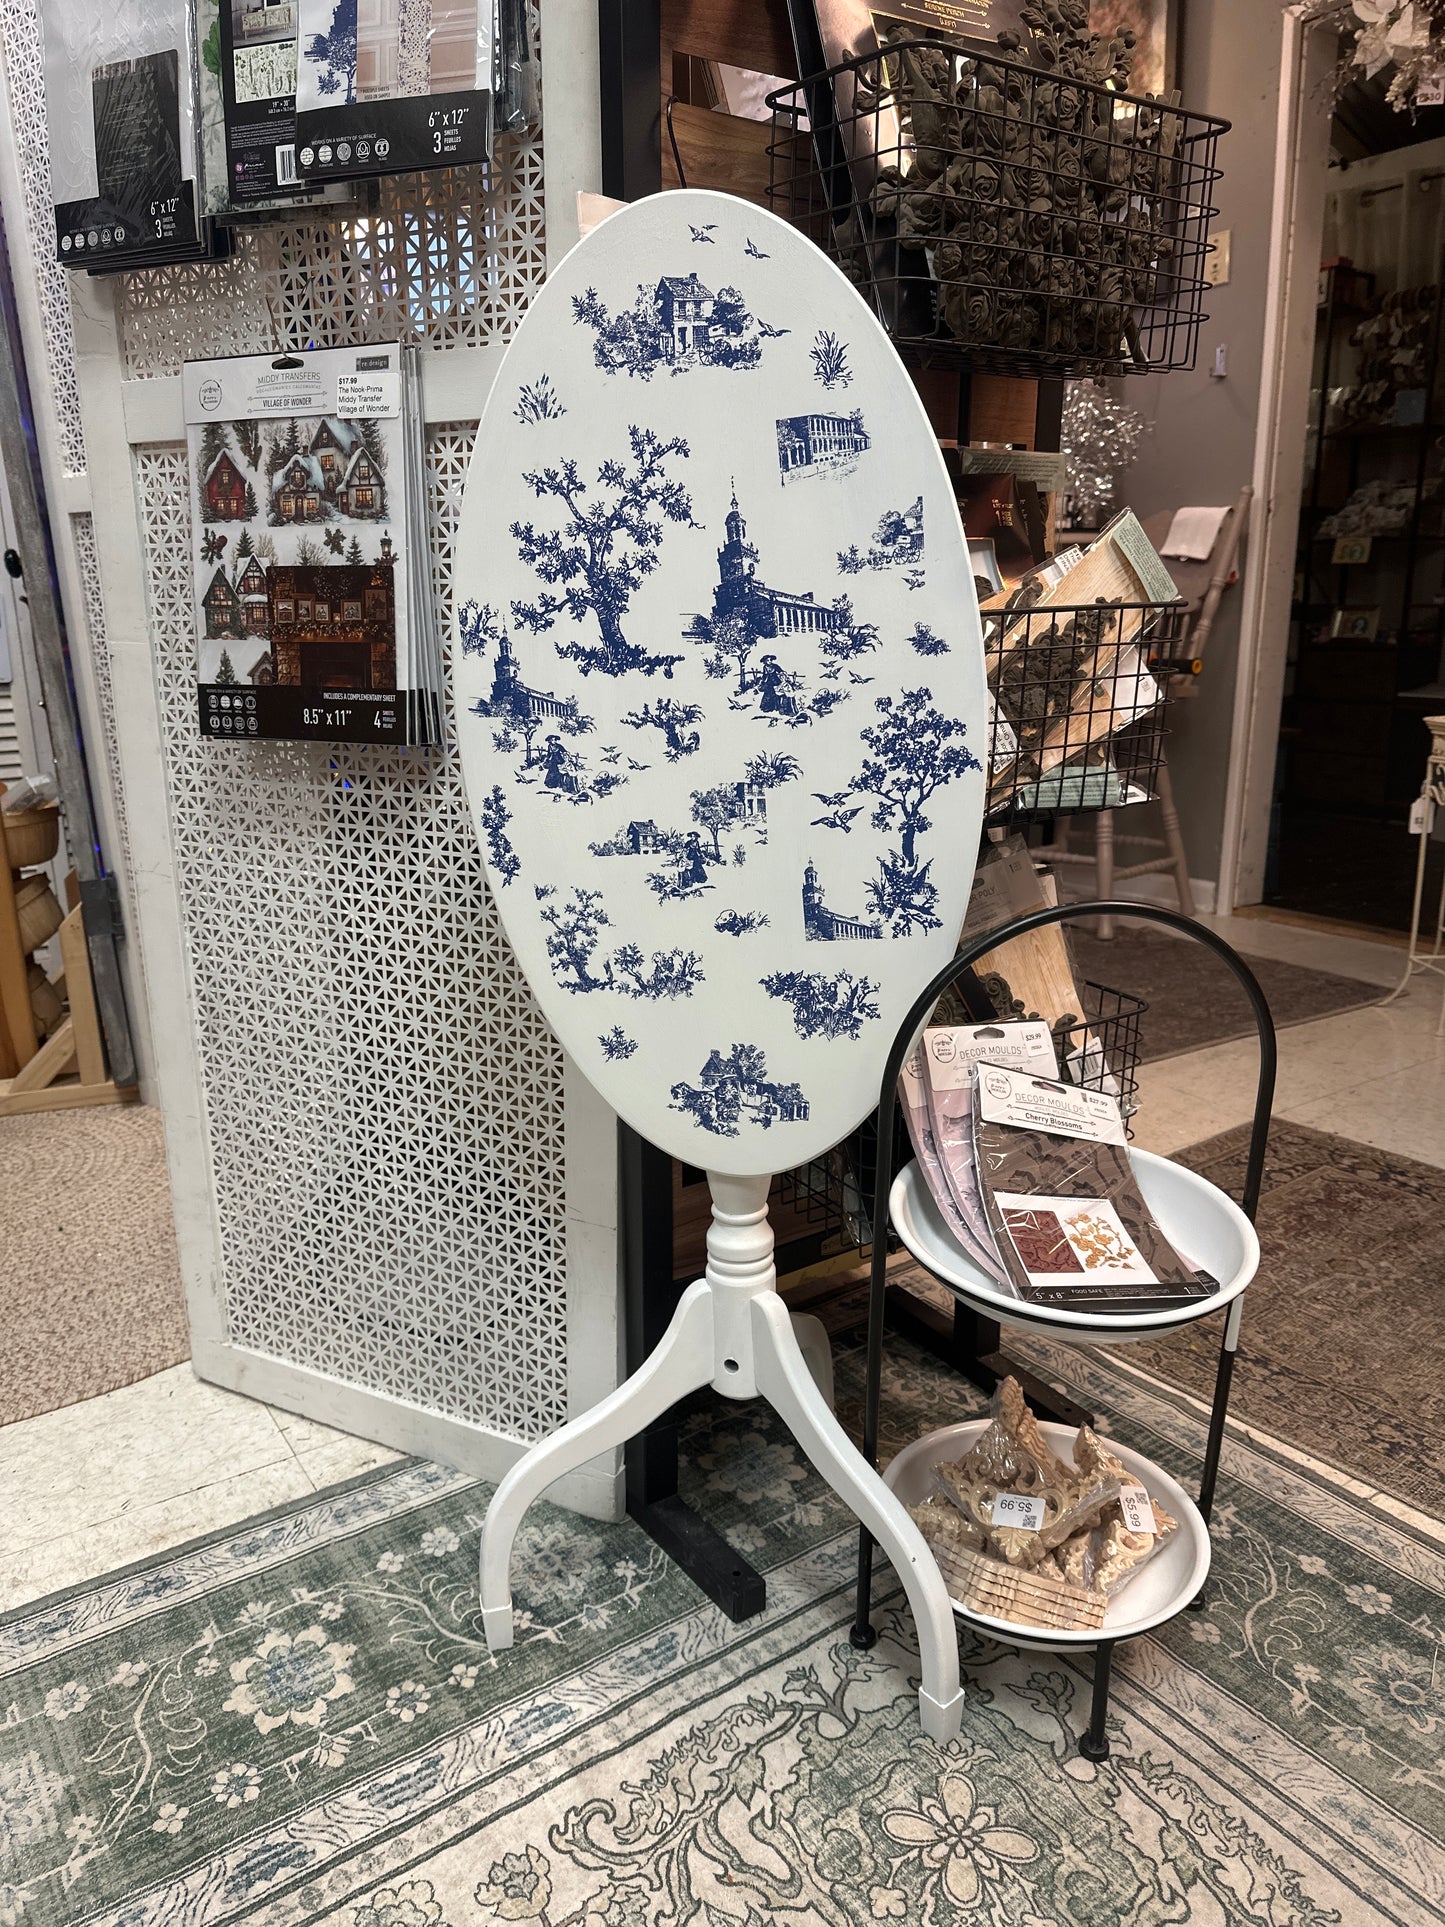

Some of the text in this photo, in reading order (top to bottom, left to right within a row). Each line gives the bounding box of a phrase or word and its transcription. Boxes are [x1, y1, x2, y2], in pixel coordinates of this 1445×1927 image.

[428, 108, 469, 128] 6" x 12"
[311, 138, 326, 146] WORKS
[433, 132, 461, 154] 3 FEUILLES
[444, 144, 456, 152] HOJAS
[150, 198, 180, 216] 6" x 12"
[155, 219, 162, 238] 3
[368, 359, 387, 368] design
[257, 372, 321, 384] MIDDY TRANSFERS
[338, 377, 358, 385] $17.99
[338, 386, 383, 394] The Nook-Prima
[263, 397, 312, 408] VILLAGE OF WONDER
[338, 394, 382, 403] Middy Transfer
[338, 405, 357, 414] Village
[366, 404, 390, 412] Wonder
[324, 692, 343, 700] INCLUDES
[347, 693, 382, 702] COMPLEMENTARY
[382, 694, 396, 702] SHEET
[304, 708, 352, 726] 8.5" x 11"
[374, 711, 381, 728] 4
[979, 886, 996, 899] POLY
[1025, 1033, 1042, 1041] $29.99
[959, 1048, 987, 1060] DECOR
[988, 1046, 1022, 1055] MOULDS
[1015, 1092, 1046, 1103] DECOR
[1047, 1098, 1085, 1114] MOULDS
[1025, 1112, 1082, 1130] Cherry Blossoms
[1036, 1292, 1045, 1300] 5"
[1184, 1286, 1190, 1294] 1
[1000, 1499, 1033, 1514] $5.99
[1126, 1497, 1142, 1527] $5.99
